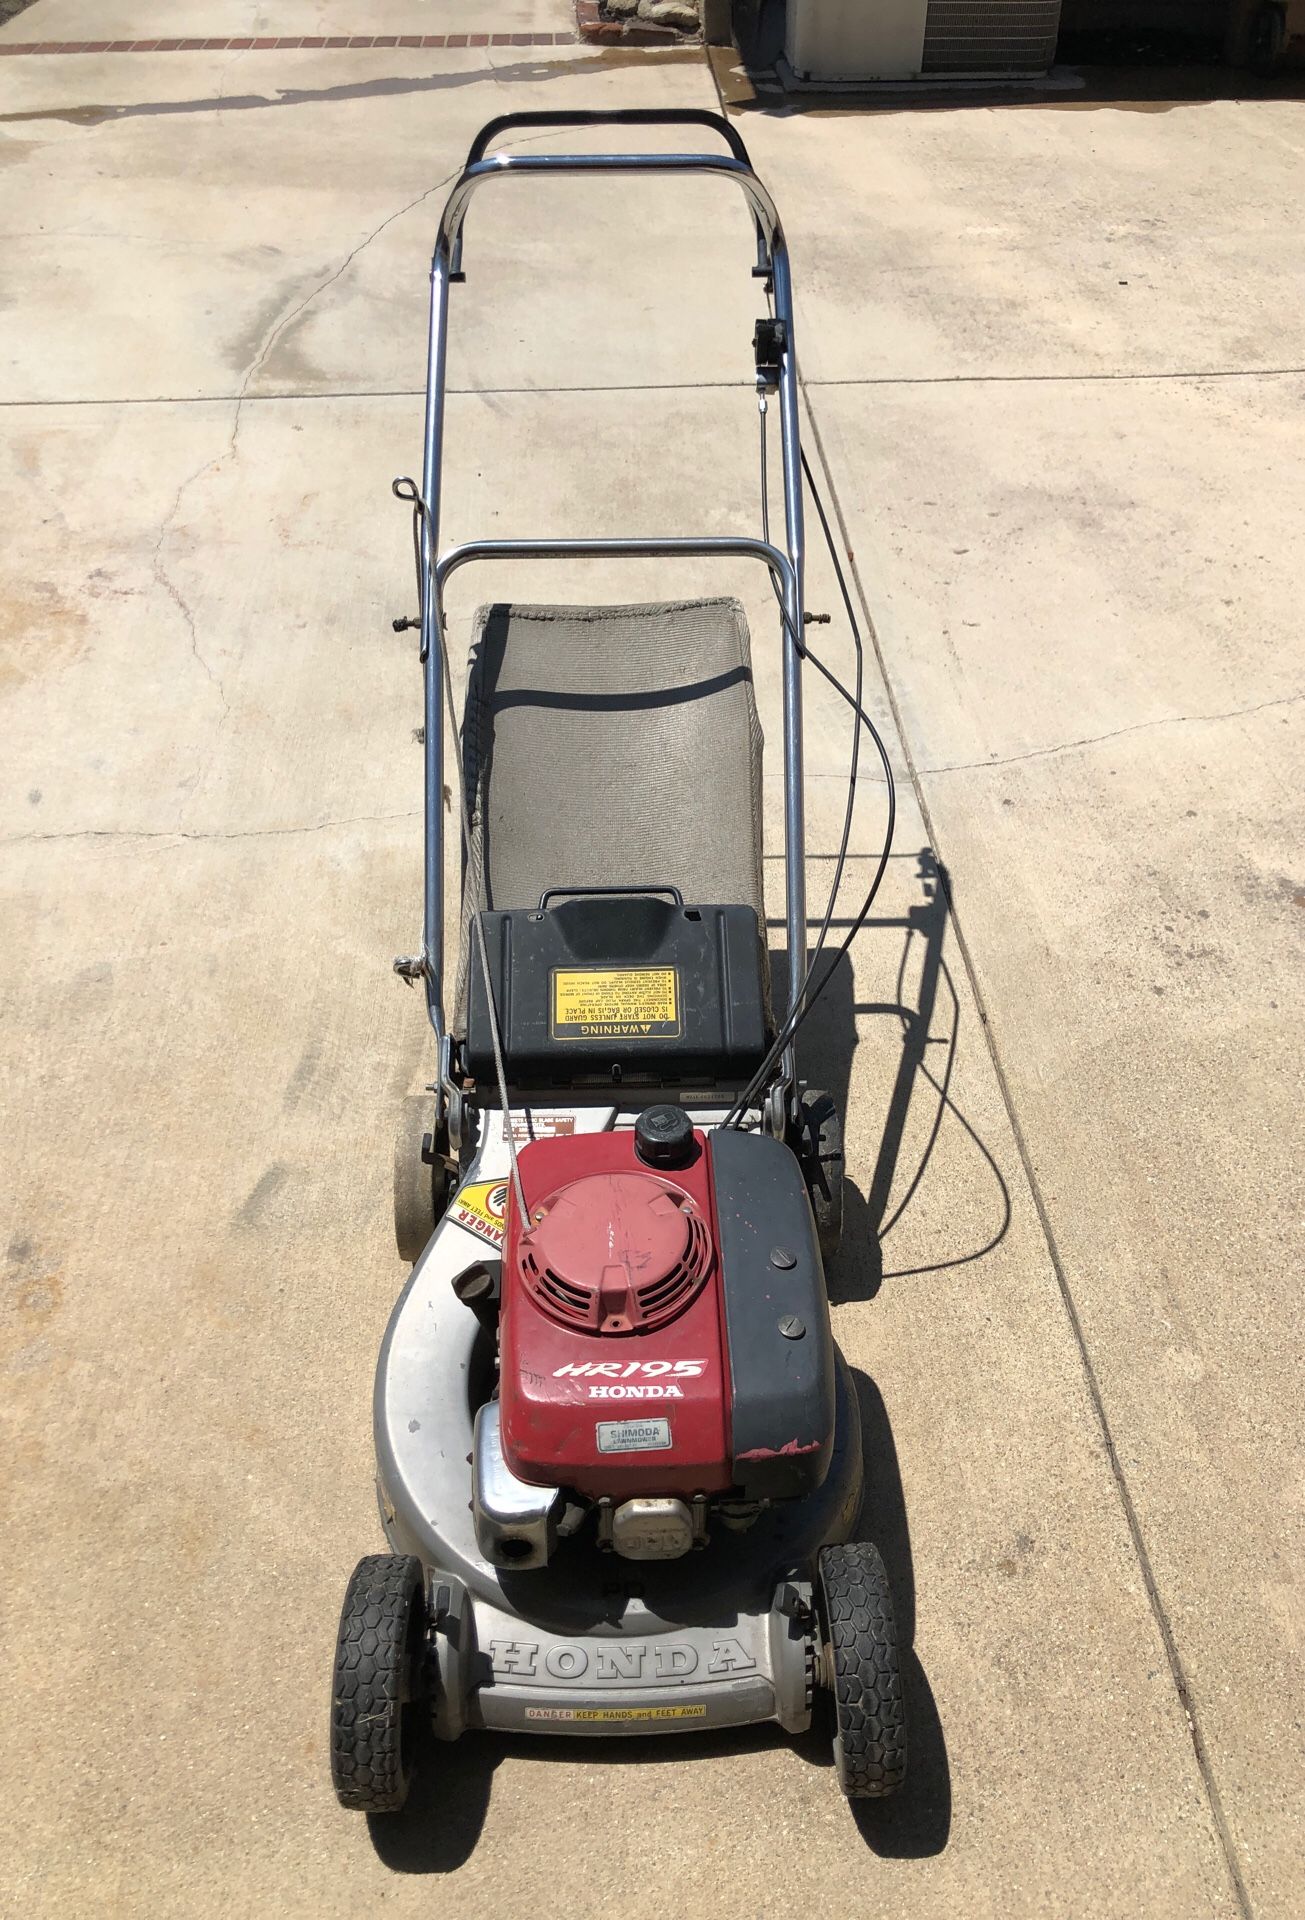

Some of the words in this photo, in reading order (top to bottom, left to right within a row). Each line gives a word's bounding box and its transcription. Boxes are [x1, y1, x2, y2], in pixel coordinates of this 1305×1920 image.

[581, 1024, 639, 1035] WARNING
[471, 1205, 484, 1217] FEET
[458, 1208, 504, 1245] ANGER
[552, 1360, 706, 1378] HR195
[588, 1384, 683, 1399] HONDA
[610, 1427, 660, 1438] SHIMODA
[489, 1639, 756, 1680] HONDA
[529, 1709, 572, 1720] DANGER
[576, 1711, 599, 1720] KEEP
[603, 1711, 633, 1720] HANDS
[637, 1710, 652, 1719] and
[656, 1709, 676, 1718] FEET
[681, 1707, 704, 1717] AWAY
